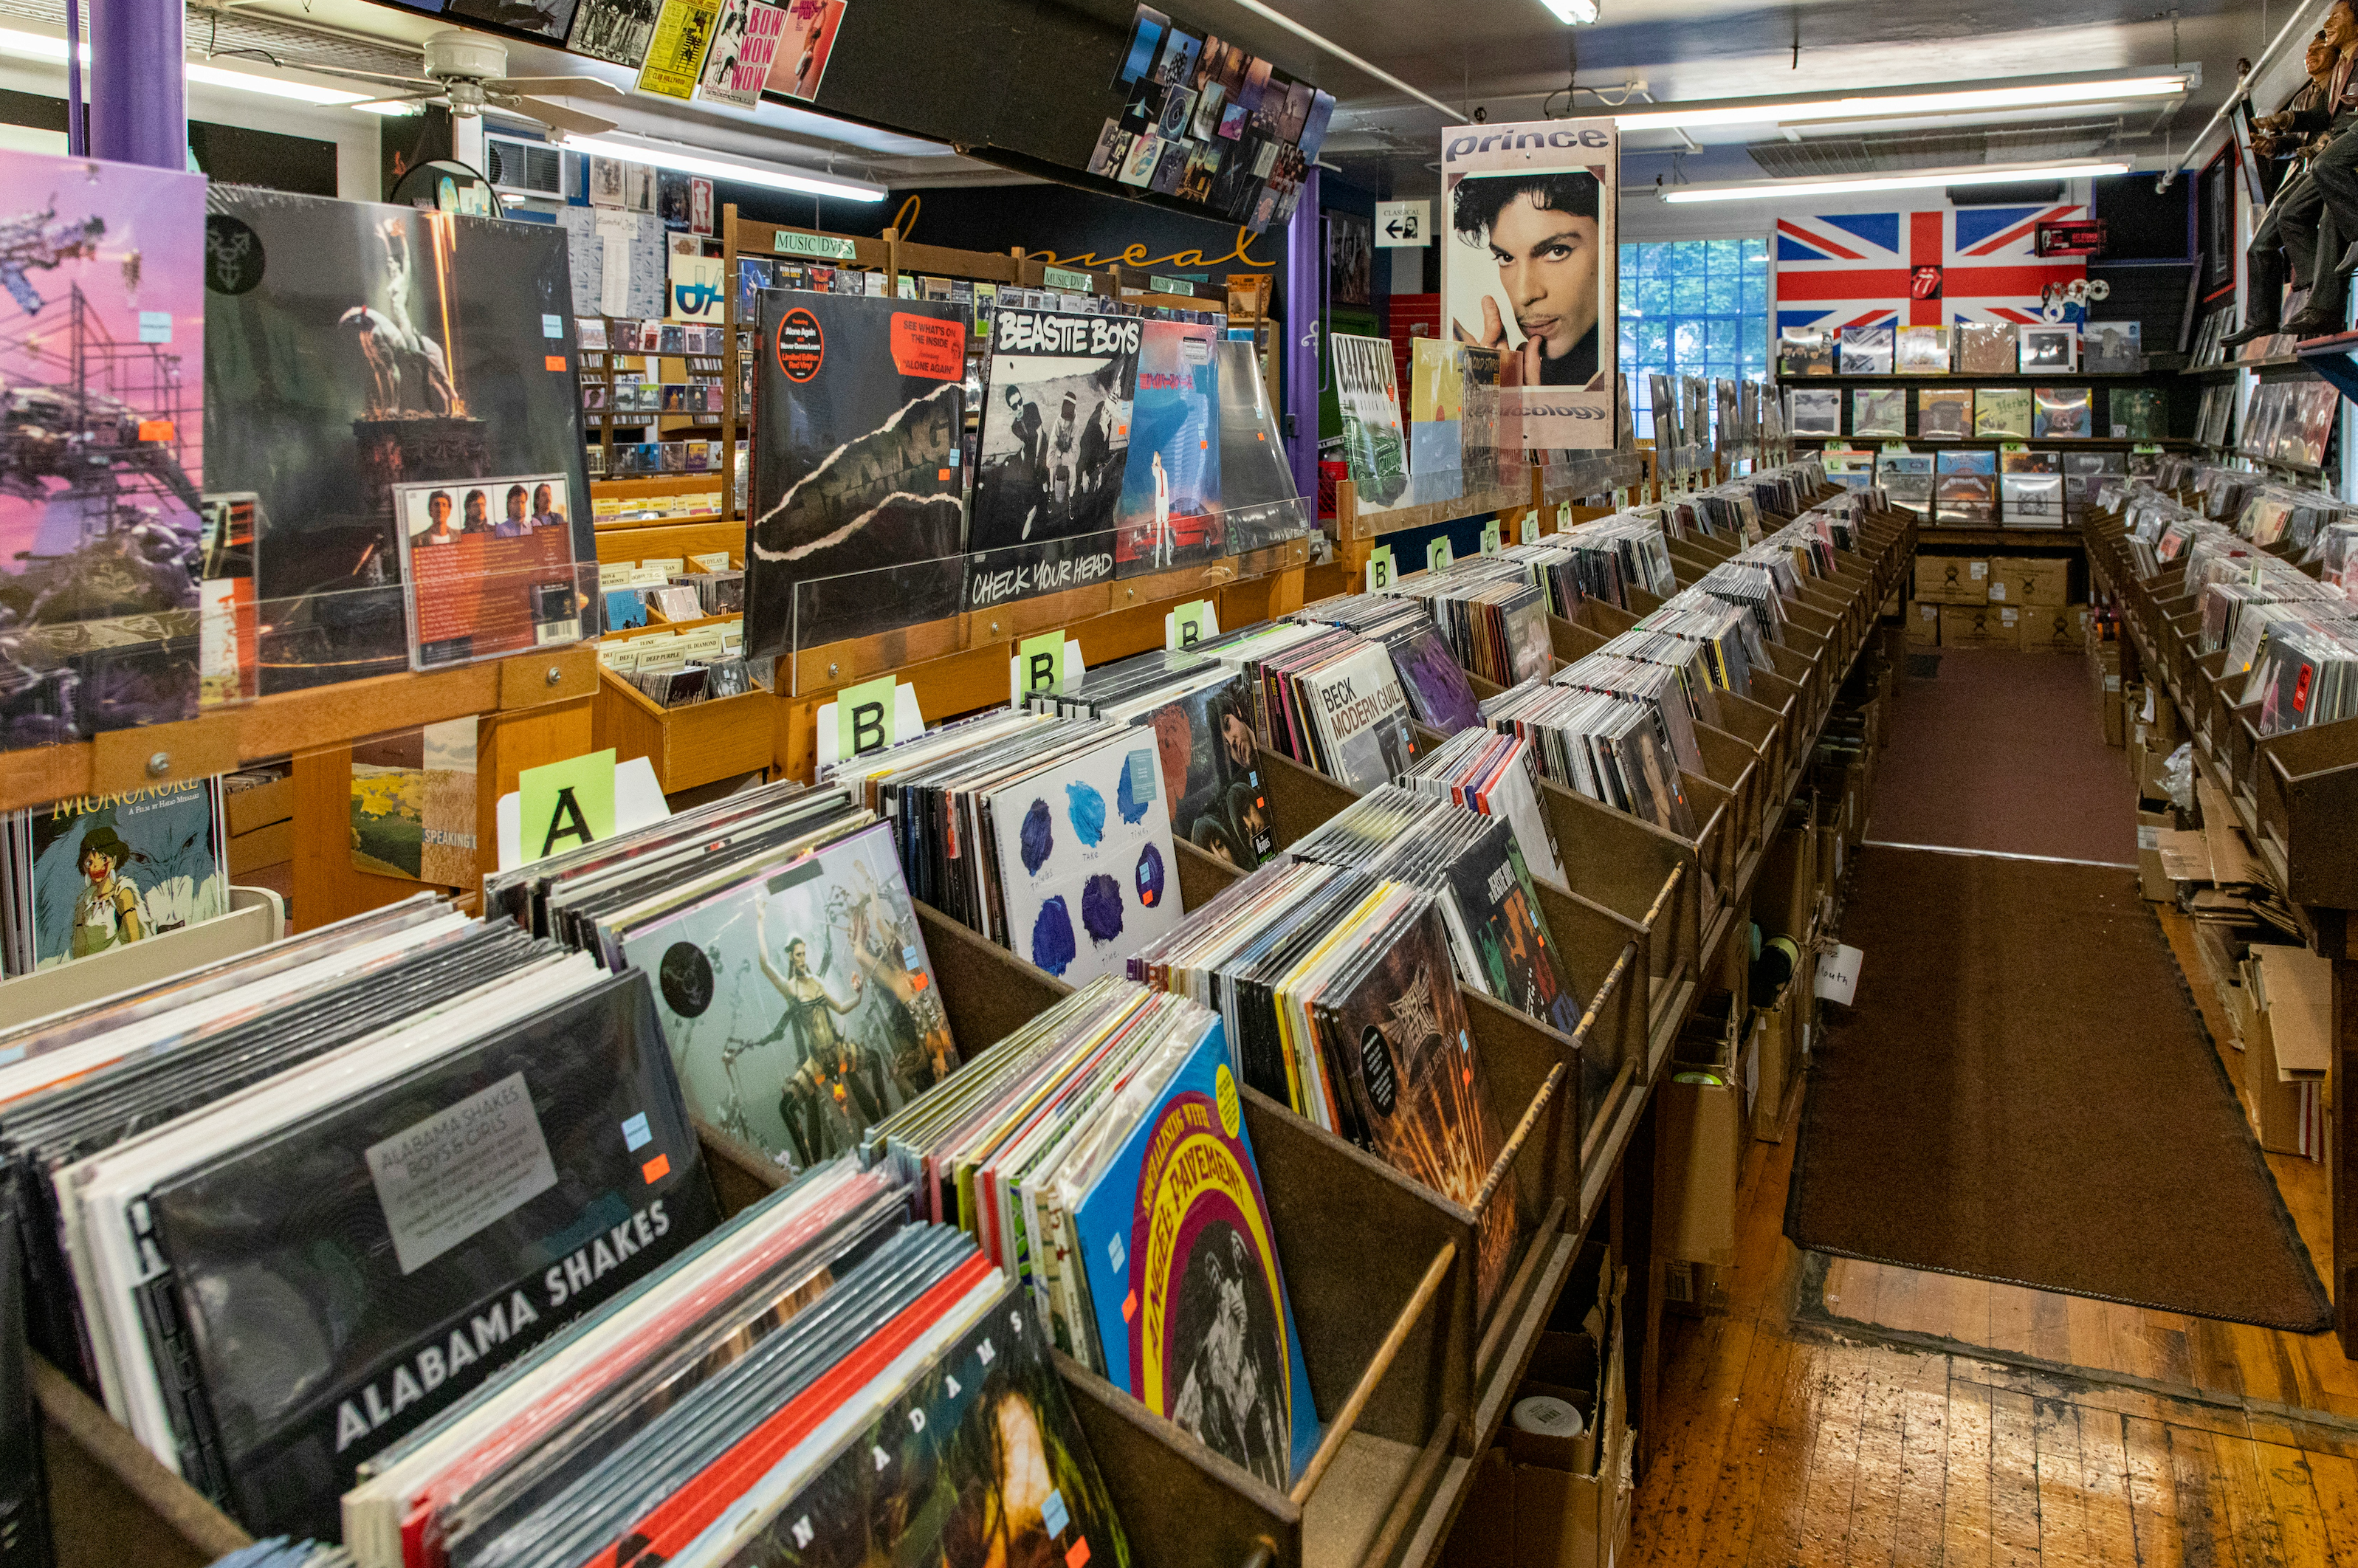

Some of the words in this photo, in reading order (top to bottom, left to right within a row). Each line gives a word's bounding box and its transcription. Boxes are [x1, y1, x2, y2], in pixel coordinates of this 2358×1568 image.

[749, 7, 785, 36] BOW
[716, 50, 722, 60] 9
[740, 35, 776, 64] WOW
[731, 64, 767, 92] WOW
[1446, 129, 1609, 162] prince
[777, 234, 817, 252] MUSIC
[676, 266, 724, 316] JA
[1045, 273, 1069, 287] MUSIC
[1152, 278, 1171, 290] MUSIC
[786, 327, 801, 335] Alone
[801, 327, 816, 337] Again
[903, 320, 917, 331] SEE
[918, 323, 945, 336] WHAT'S
[946, 328, 956, 338] ON
[911, 334, 924, 344] THE
[926, 337, 949, 348] INSIDE
[998, 311, 1087, 354] BEASTIE
[1090, 318, 1140, 356] BOYS
[800, 361, 813, 371] Vinyl
[1336, 334, 1396, 396] CALEXICO
[1484, 404, 1606, 421] icology
[1829, 441, 1840, 450] M
[1830, 461, 1839, 470] L
[1486, 530, 1495, 553] C
[707, 557, 723, 565] DYLAN
[1434, 548, 1445, 571] C
[972, 567, 1031, 605] CHECK
[1033, 558, 1072, 591] YOUR
[1073, 552, 1113, 583] HEAD
[1375, 560, 1386, 588] B
[692, 640, 717, 650] DIAMOND
[1182, 620, 1198, 647] B
[646, 654, 658, 662] DEEP
[659, 652, 680, 661] PURPLE
[1029, 653, 1054, 694] B
[1321, 677, 1358, 713] BECK
[1330, 694, 1380, 741] MODERN
[1377, 679, 1403, 712] GUILT
[851, 701, 885, 754] B
[540, 785, 595, 859] A
[424, 829, 470, 848] SPEAKING
[381, 1117, 461, 1170] ALABAMA
[461, 1084, 519, 1127] SHAKES
[1182, 1102, 1211, 1129] WITH
[407, 1146, 452, 1180] BOYS
[466, 1113, 508, 1146] GIRLS
[1169, 1144, 1245, 1214] PAVEMENT
[335, 1290, 540, 1454] ALABAMA
[545, 1200, 671, 1307] SHAKES
